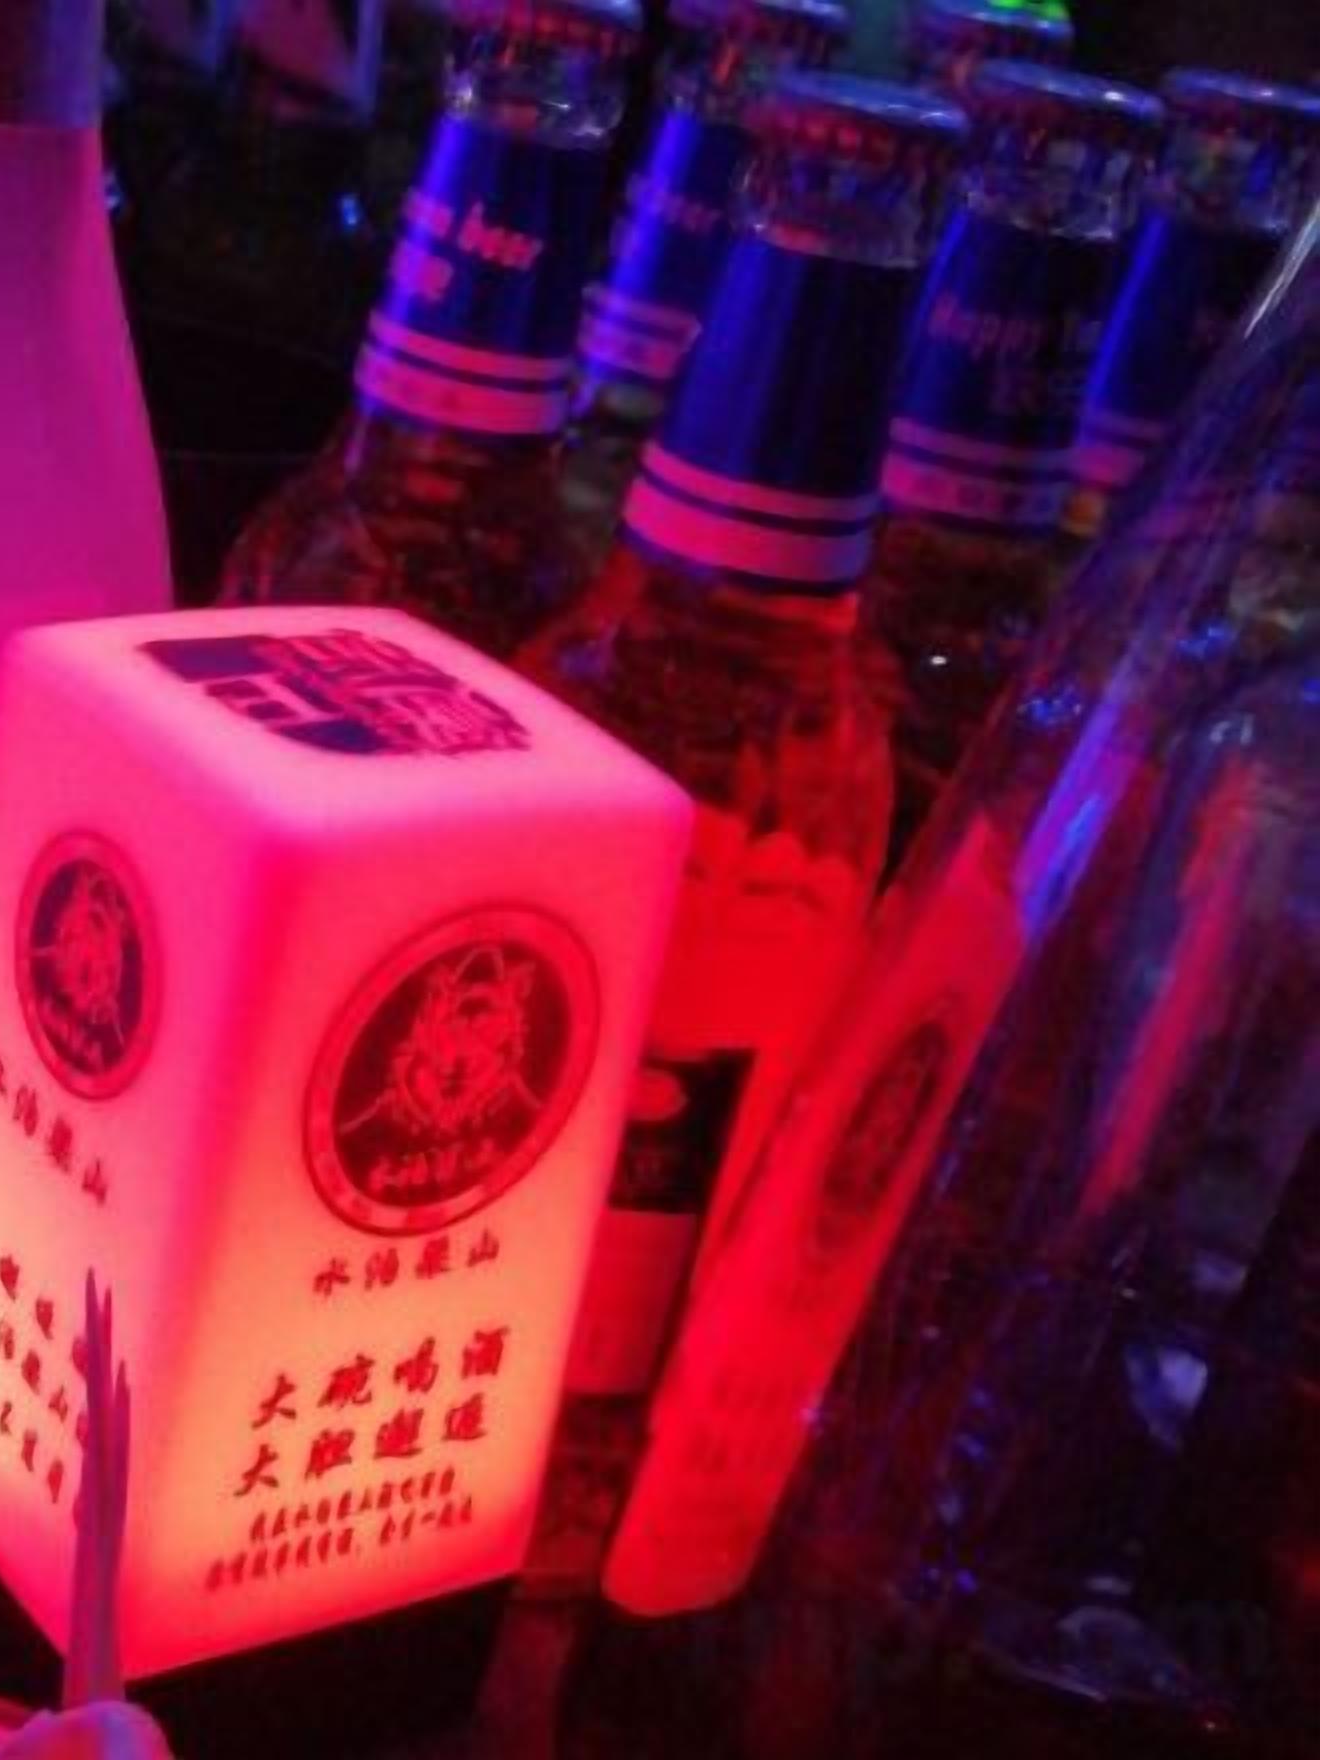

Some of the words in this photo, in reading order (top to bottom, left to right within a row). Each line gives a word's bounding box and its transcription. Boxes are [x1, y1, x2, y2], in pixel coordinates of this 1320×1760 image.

[313, 1229, 500, 1298] 水泊梁山
[251, 1327, 511, 1429] 大碗喝酒
